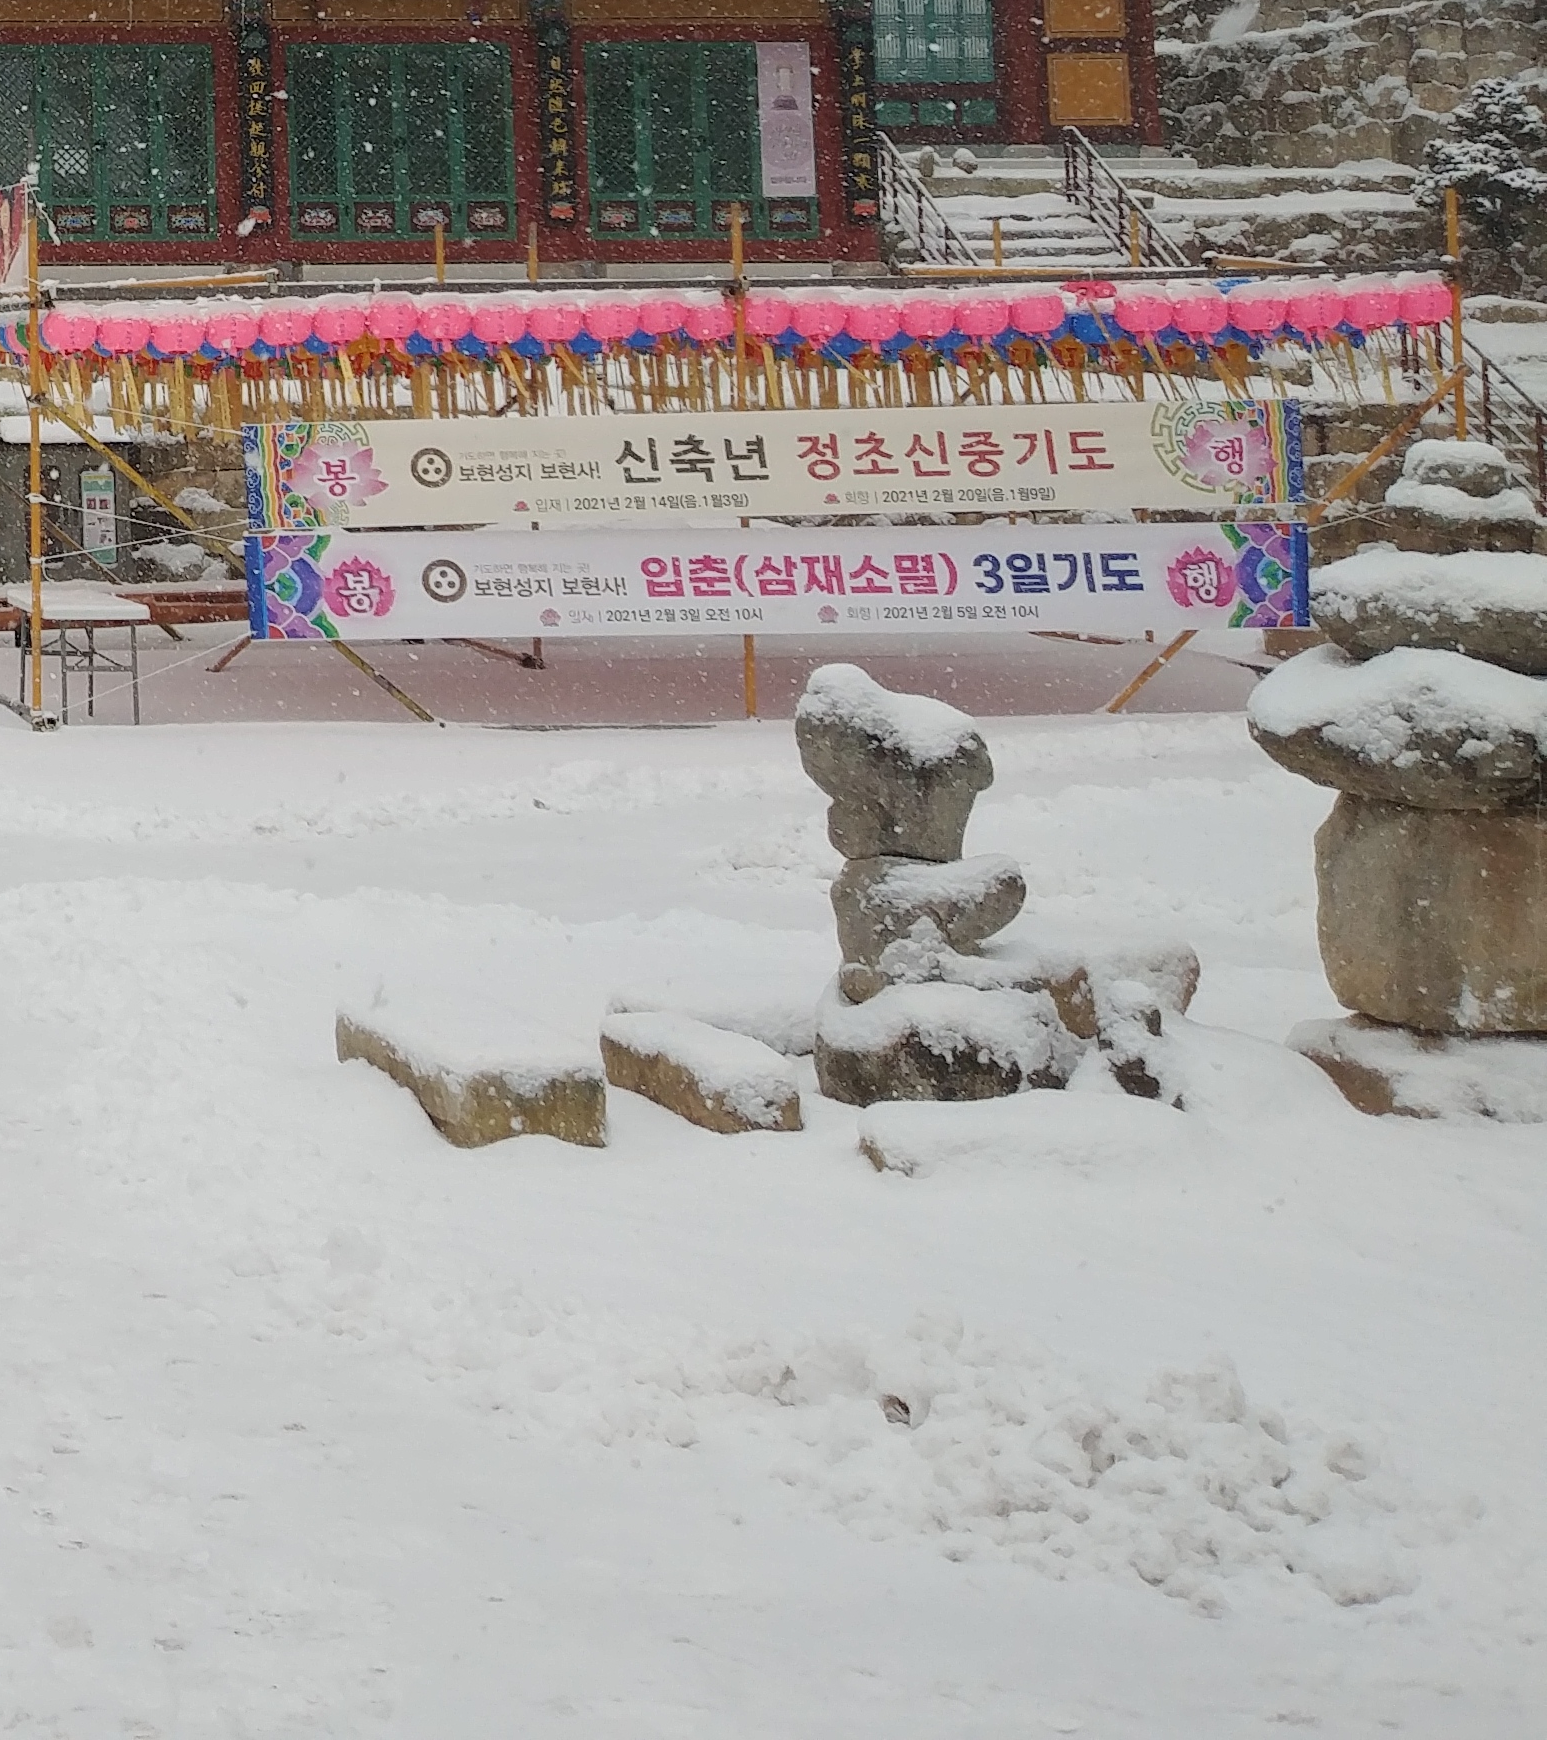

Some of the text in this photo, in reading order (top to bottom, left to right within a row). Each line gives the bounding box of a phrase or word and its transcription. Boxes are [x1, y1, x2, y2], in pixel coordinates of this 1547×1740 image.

[615, 429, 1115, 483] 신축년 정초신중기도
[1209, 437, 1245, 476] 행
[315, 457, 357, 497] 봉
[459, 461, 601, 482] 보현성지 보현사!
[574, 497, 620, 510] 2021년
[624, 496, 646, 509] 2월
[883, 490, 928, 503] 2021년
[932, 489, 954, 503] 2월
[474, 577, 627, 597] 보현성지 보현사!
[640, 552, 1145, 597] 입춘(삼재소멸) 3일기도
[1182, 565, 1218, 602] 행
[336, 571, 380, 613] 봉
[607, 609, 651, 622] 2021년
[656, 608, 676, 622] 2월
[680, 608, 701, 622] 3일
[705, 608, 730, 621] 오전
[735, 607, 764, 621] 10시
[884, 606, 929, 620] 2021년
[933, 606, 953, 620] 2월
[957, 605, 978, 619] 5일
[982, 605, 1007, 619] 오전
[1012, 605, 1039, 618] 10시
